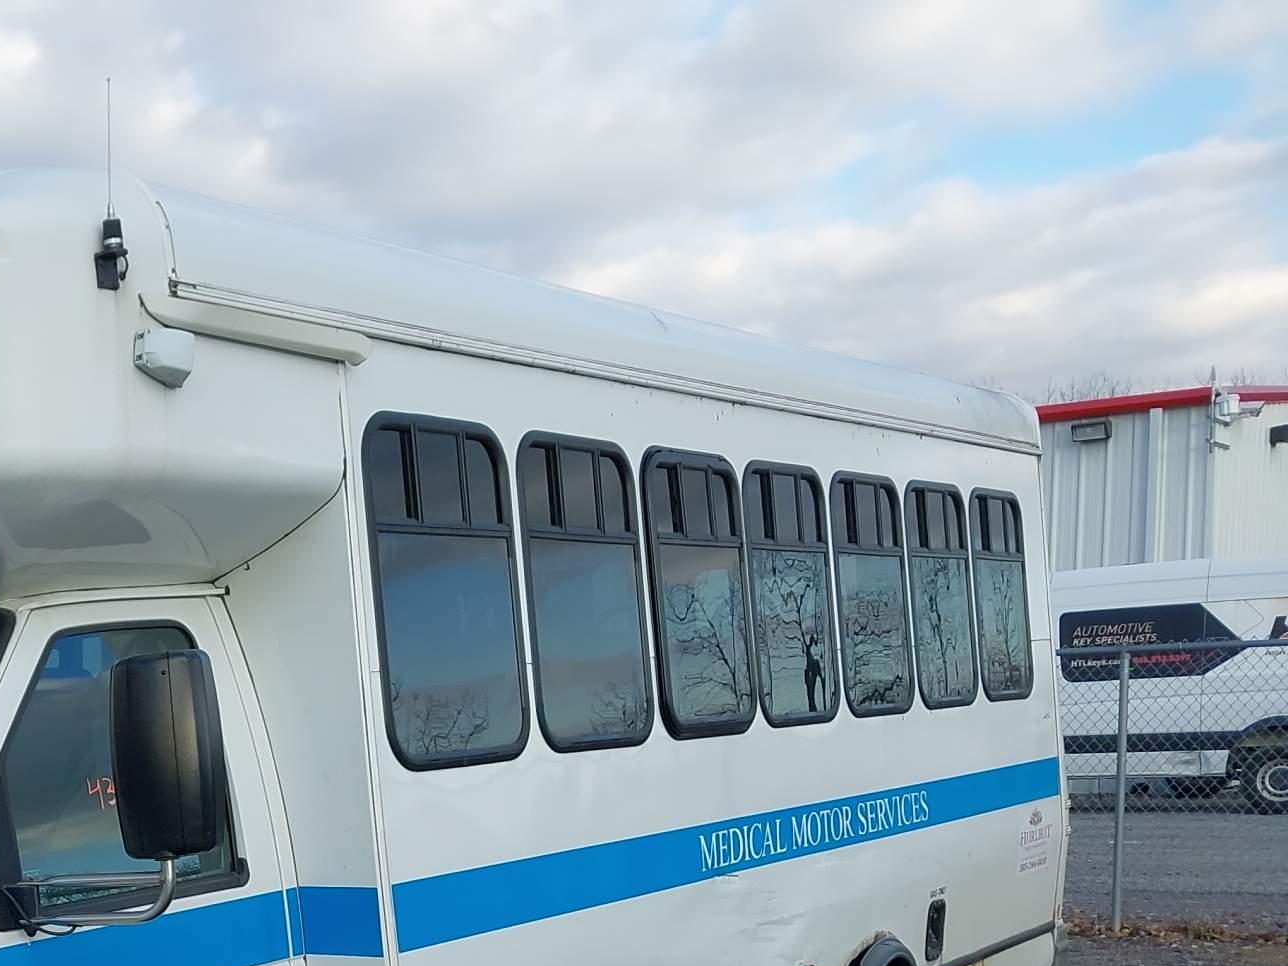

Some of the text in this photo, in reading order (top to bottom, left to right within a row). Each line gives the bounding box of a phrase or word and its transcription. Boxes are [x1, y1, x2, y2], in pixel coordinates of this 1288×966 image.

[1072, 622, 1154, 637] AUTOMOTIVE
[1072, 633, 1158, 646] KEY SPECIALISTS
[1071, 658, 1121, 668] HTLkeys.co
[699, 790, 929, 872] MEDICAL MOTOR SERVICES
